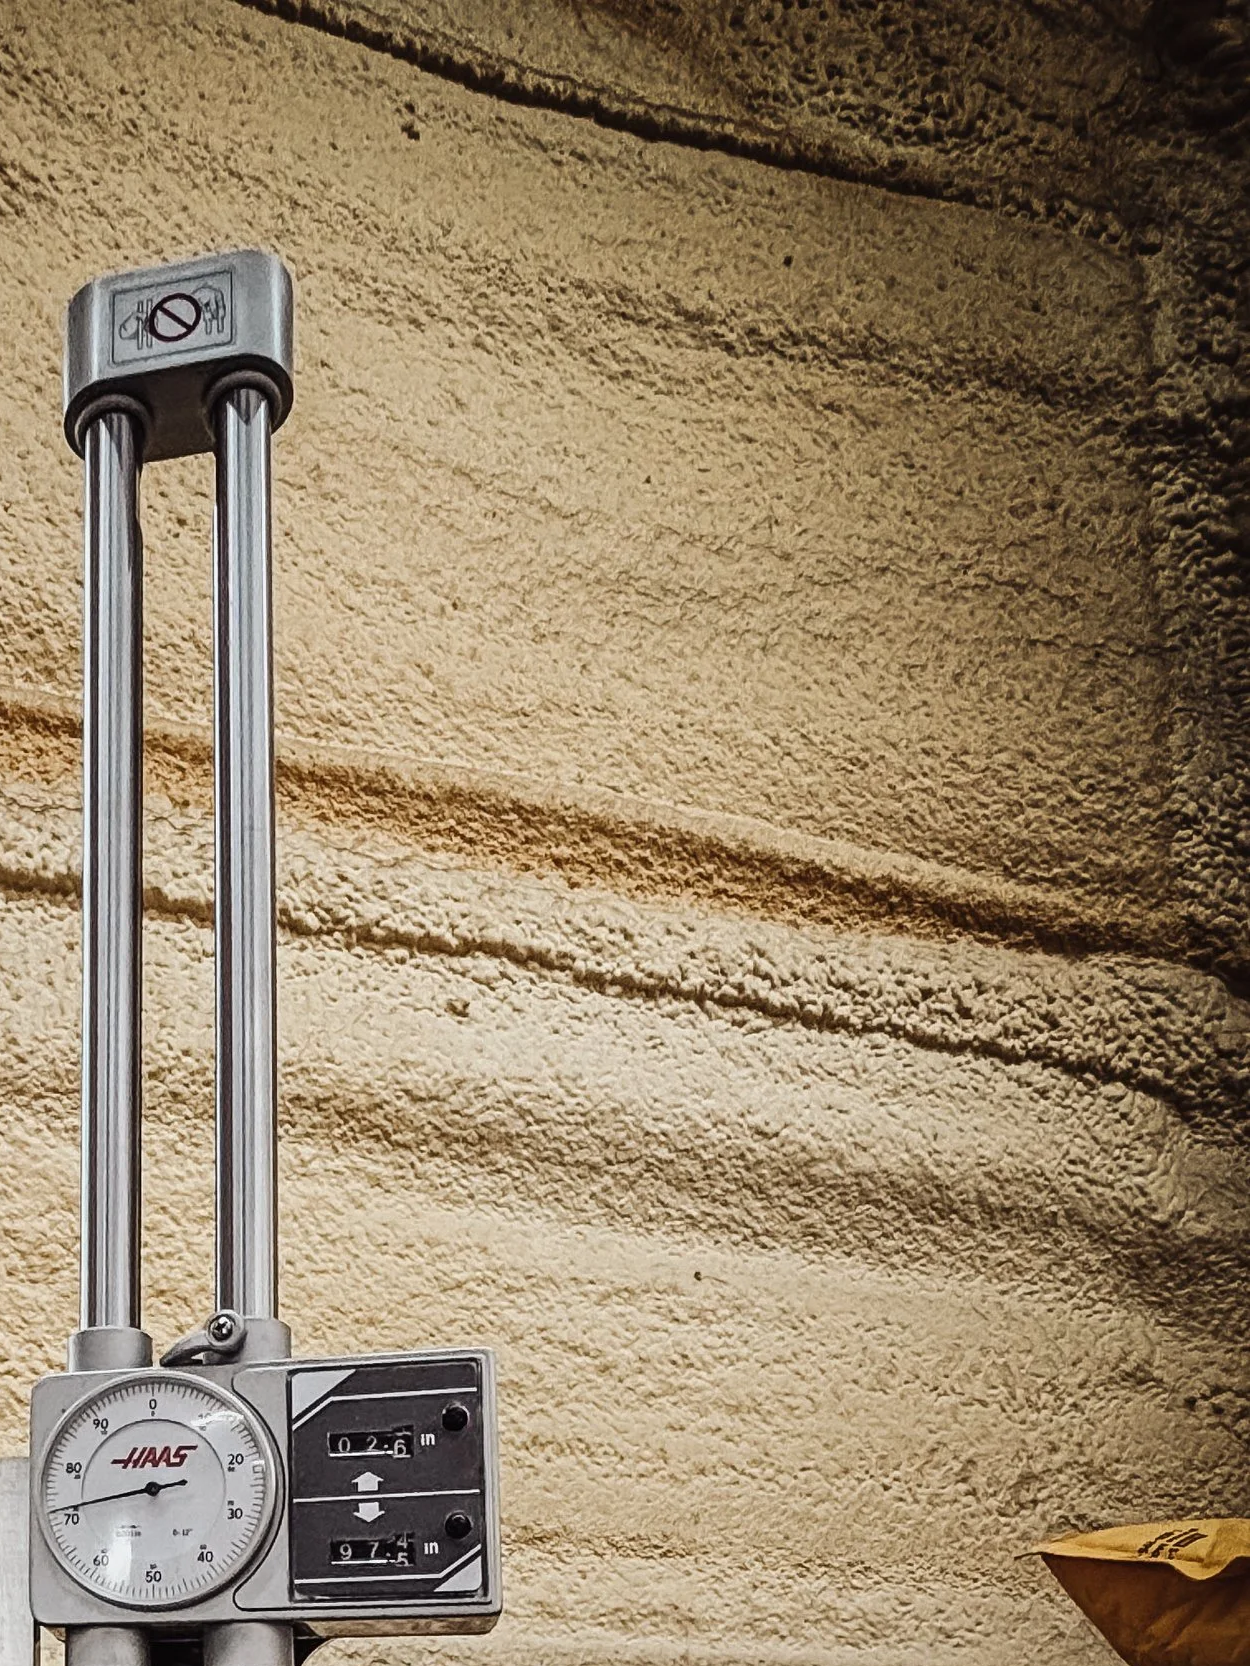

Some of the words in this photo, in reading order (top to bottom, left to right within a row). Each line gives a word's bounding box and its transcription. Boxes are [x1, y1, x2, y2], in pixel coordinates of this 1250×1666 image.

[149, 1399, 157, 1410] 0
[93, 1418, 109, 1430] 90
[420, 1433, 435, 1446] in
[111, 1445, 198, 1469] HAAS
[228, 1453, 244, 1465] 20
[66, 1462, 82, 1474] 80
[64, 1513, 80, 1525] 70
[227, 1507, 243, 1520] 30
[424, 1541, 439, 1555] in
[93, 1554, 109, 1567] 60
[197, 1551, 214, 1563] 40
[145, 1570, 162, 1583] 50
